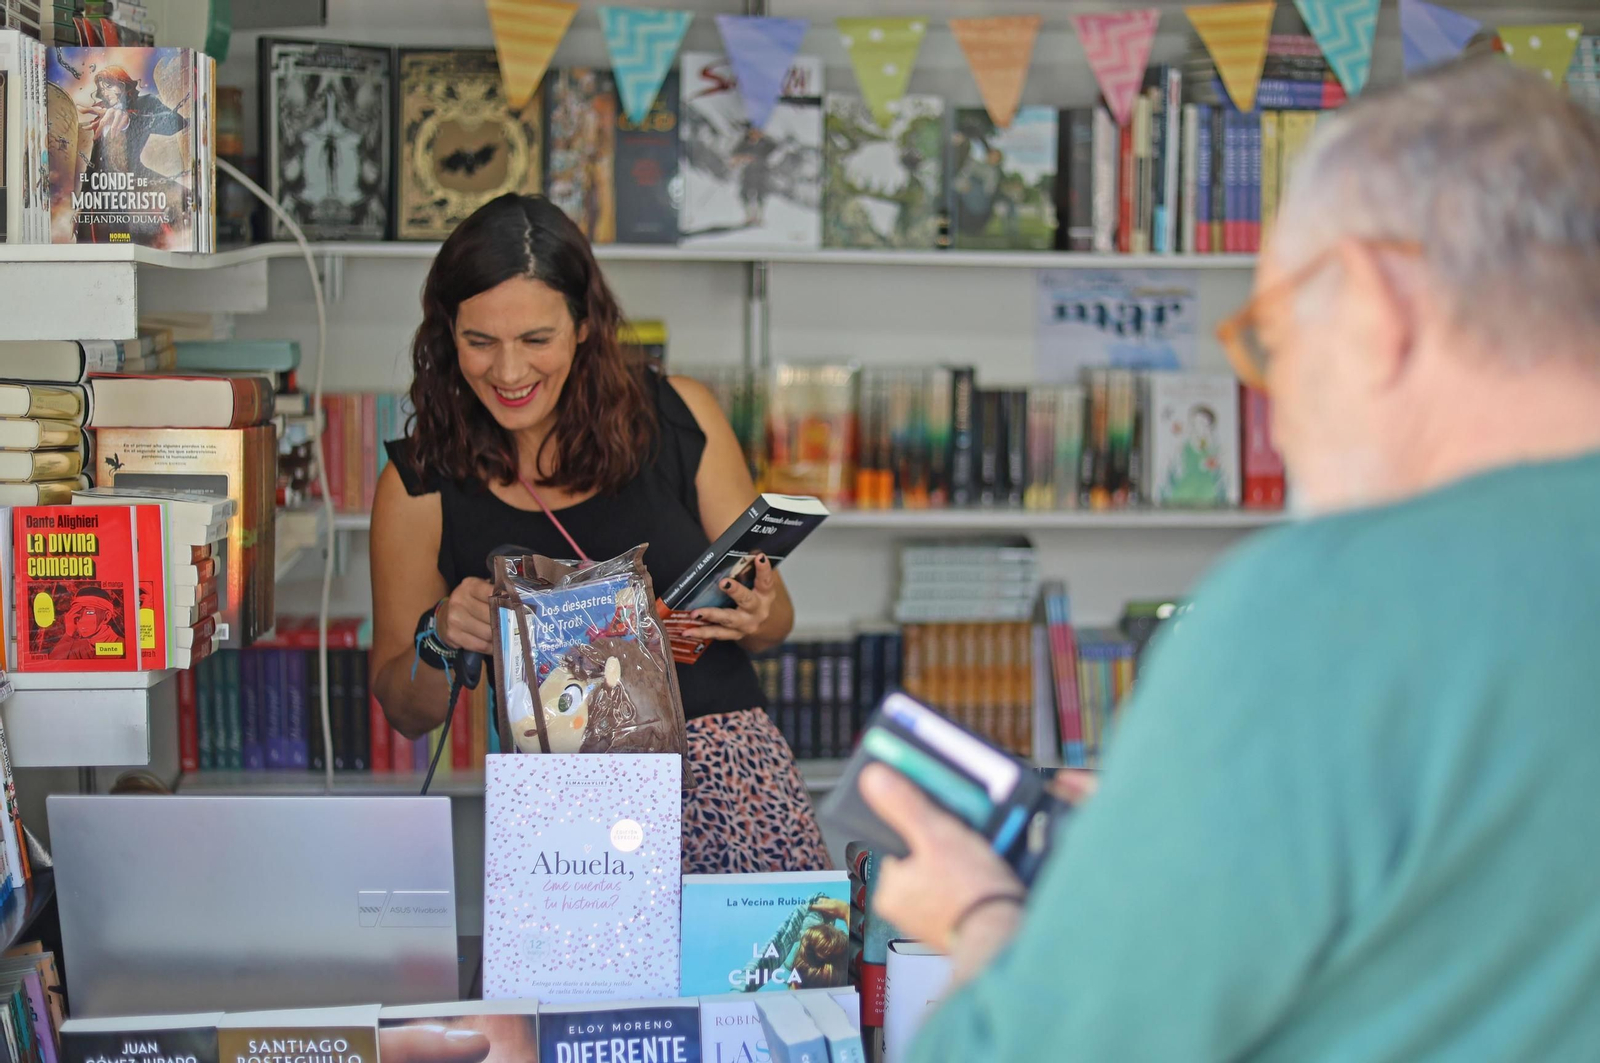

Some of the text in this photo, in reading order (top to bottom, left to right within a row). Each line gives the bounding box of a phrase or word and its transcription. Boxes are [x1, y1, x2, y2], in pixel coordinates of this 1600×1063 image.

[80, 172, 148, 190] EL CONDE DE
[71, 192, 167, 210] MONTECRISTO
[72, 214, 170, 225] ALEJANDRO DUMAS
[26, 514, 98, 530] Dante Alighieri
[541, 595, 612, 617] Los desastres
[541, 623, 555, 633] de
[530, 851, 634, 881] Abuela,
[574, 878, 621, 892] cuentas
[544, 894, 620, 911] tu historia?
[727, 897, 806, 907] La Vecina Rubia
[752, 942, 780, 959] LA
[728, 967, 802, 985] CHICA
[569, 1020, 673, 1035] ELOY MORENO
[122, 1042, 158, 1054] JUAN
[249, 1039, 348, 1054] SANTIAGO
[556, 1036, 687, 1063] DIFERENTE
